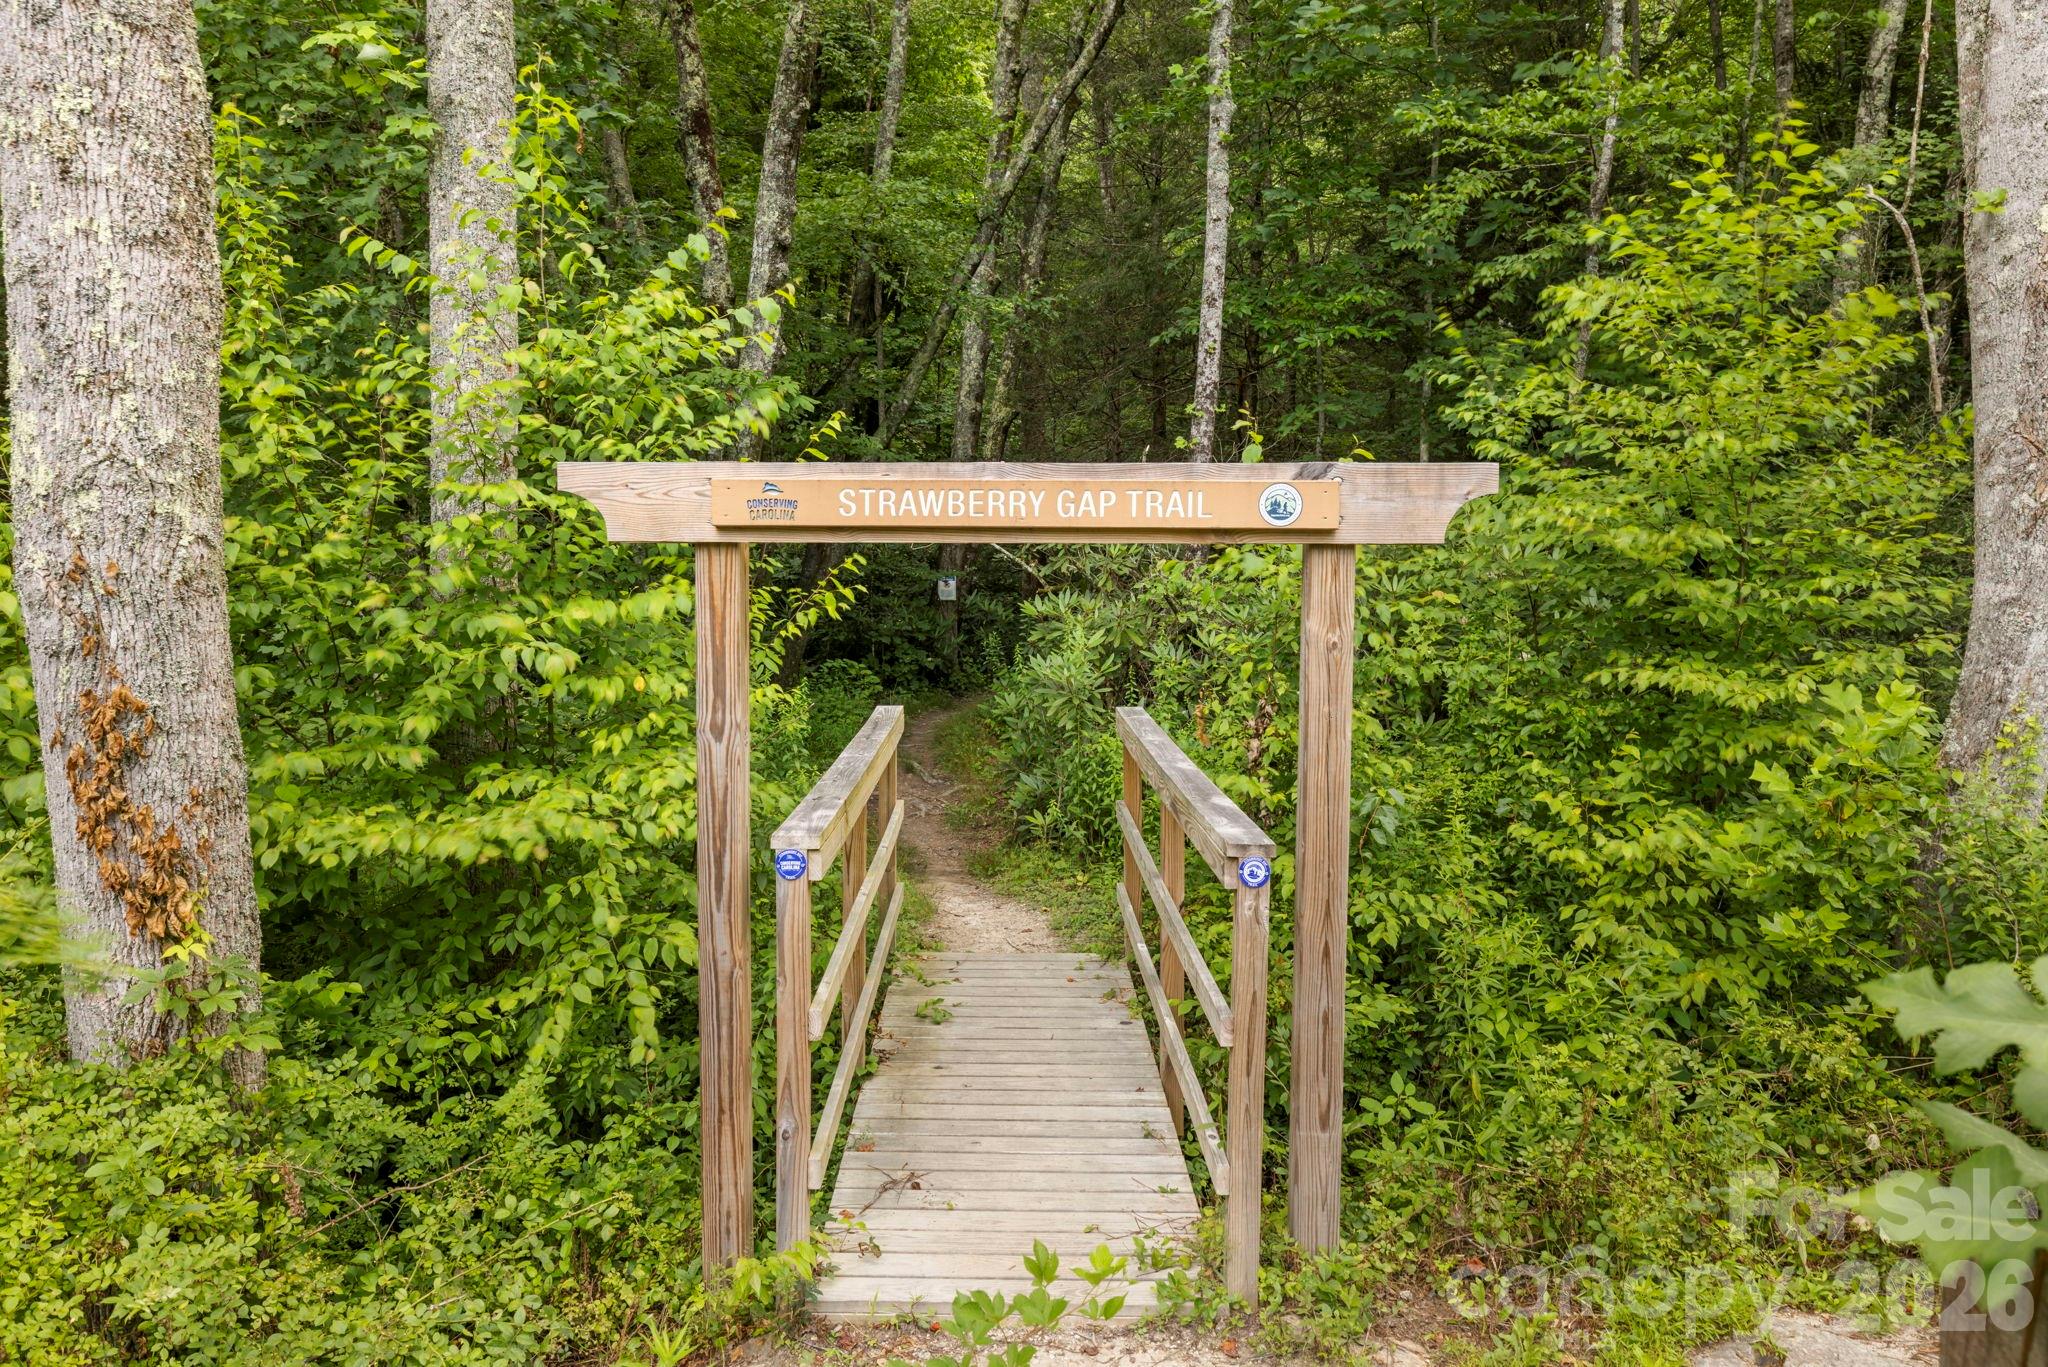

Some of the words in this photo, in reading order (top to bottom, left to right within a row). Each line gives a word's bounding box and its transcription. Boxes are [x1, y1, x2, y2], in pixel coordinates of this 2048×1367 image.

[746, 498, 798, 509] CONSERVING
[838, 489, 1045, 517] STRAWBERRY
[1056, 489, 1117, 517] GAP
[1126, 489, 1213, 517] TRAIL
[749, 509, 796, 520] CAROLINA
